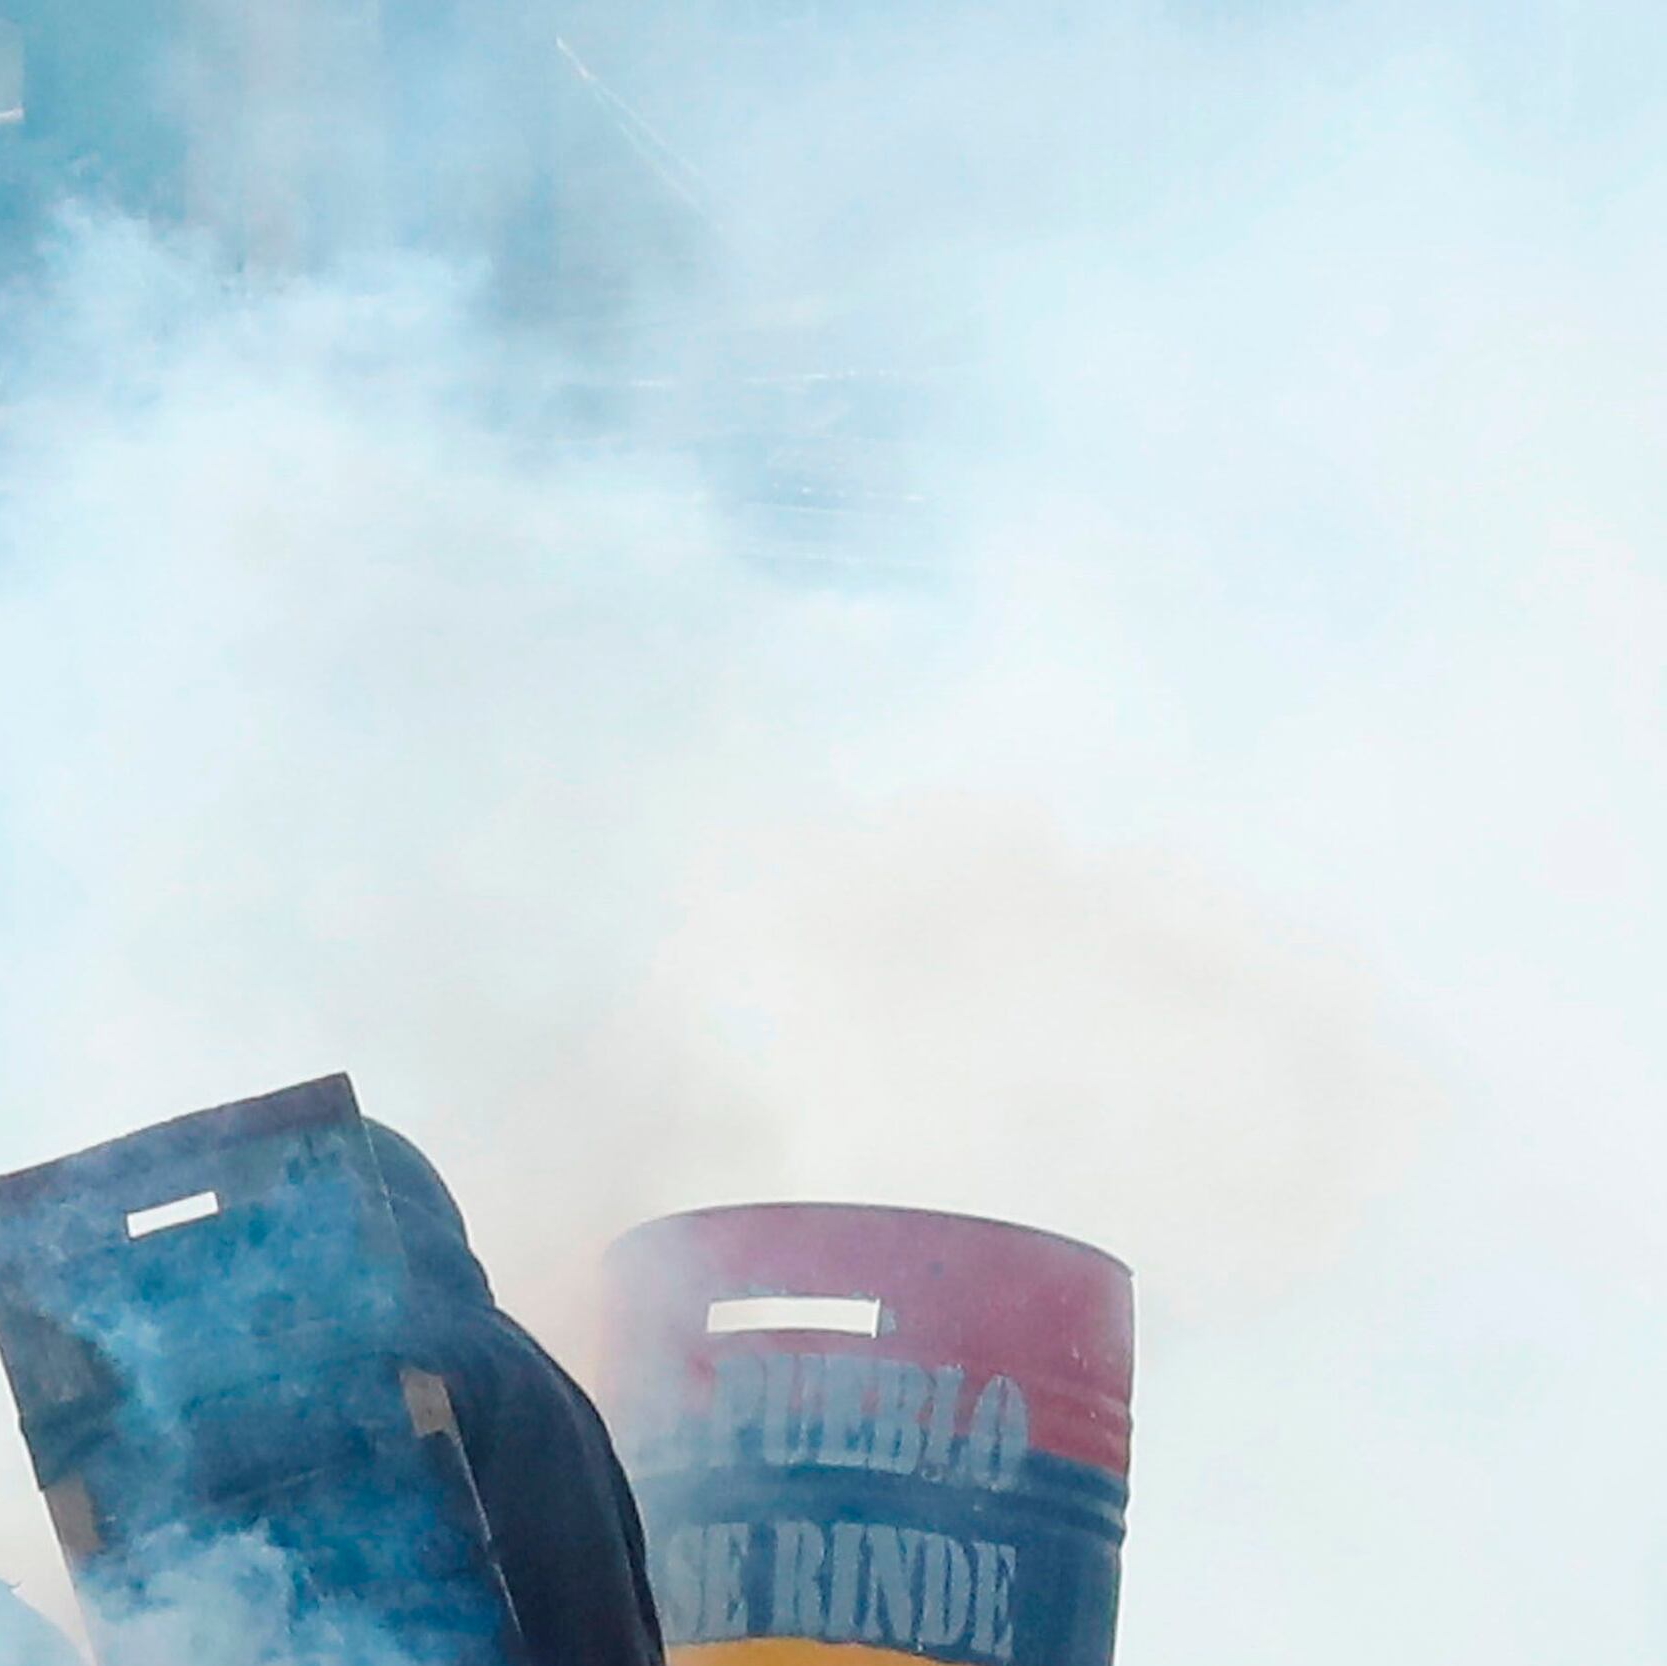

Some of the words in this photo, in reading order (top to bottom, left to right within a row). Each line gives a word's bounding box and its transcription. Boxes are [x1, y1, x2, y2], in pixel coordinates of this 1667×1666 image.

[707, 1353, 1031, 1491] PUEBLO
[662, 1522, 748, 1644] SE
[771, 1520, 1018, 1662] RINDE
